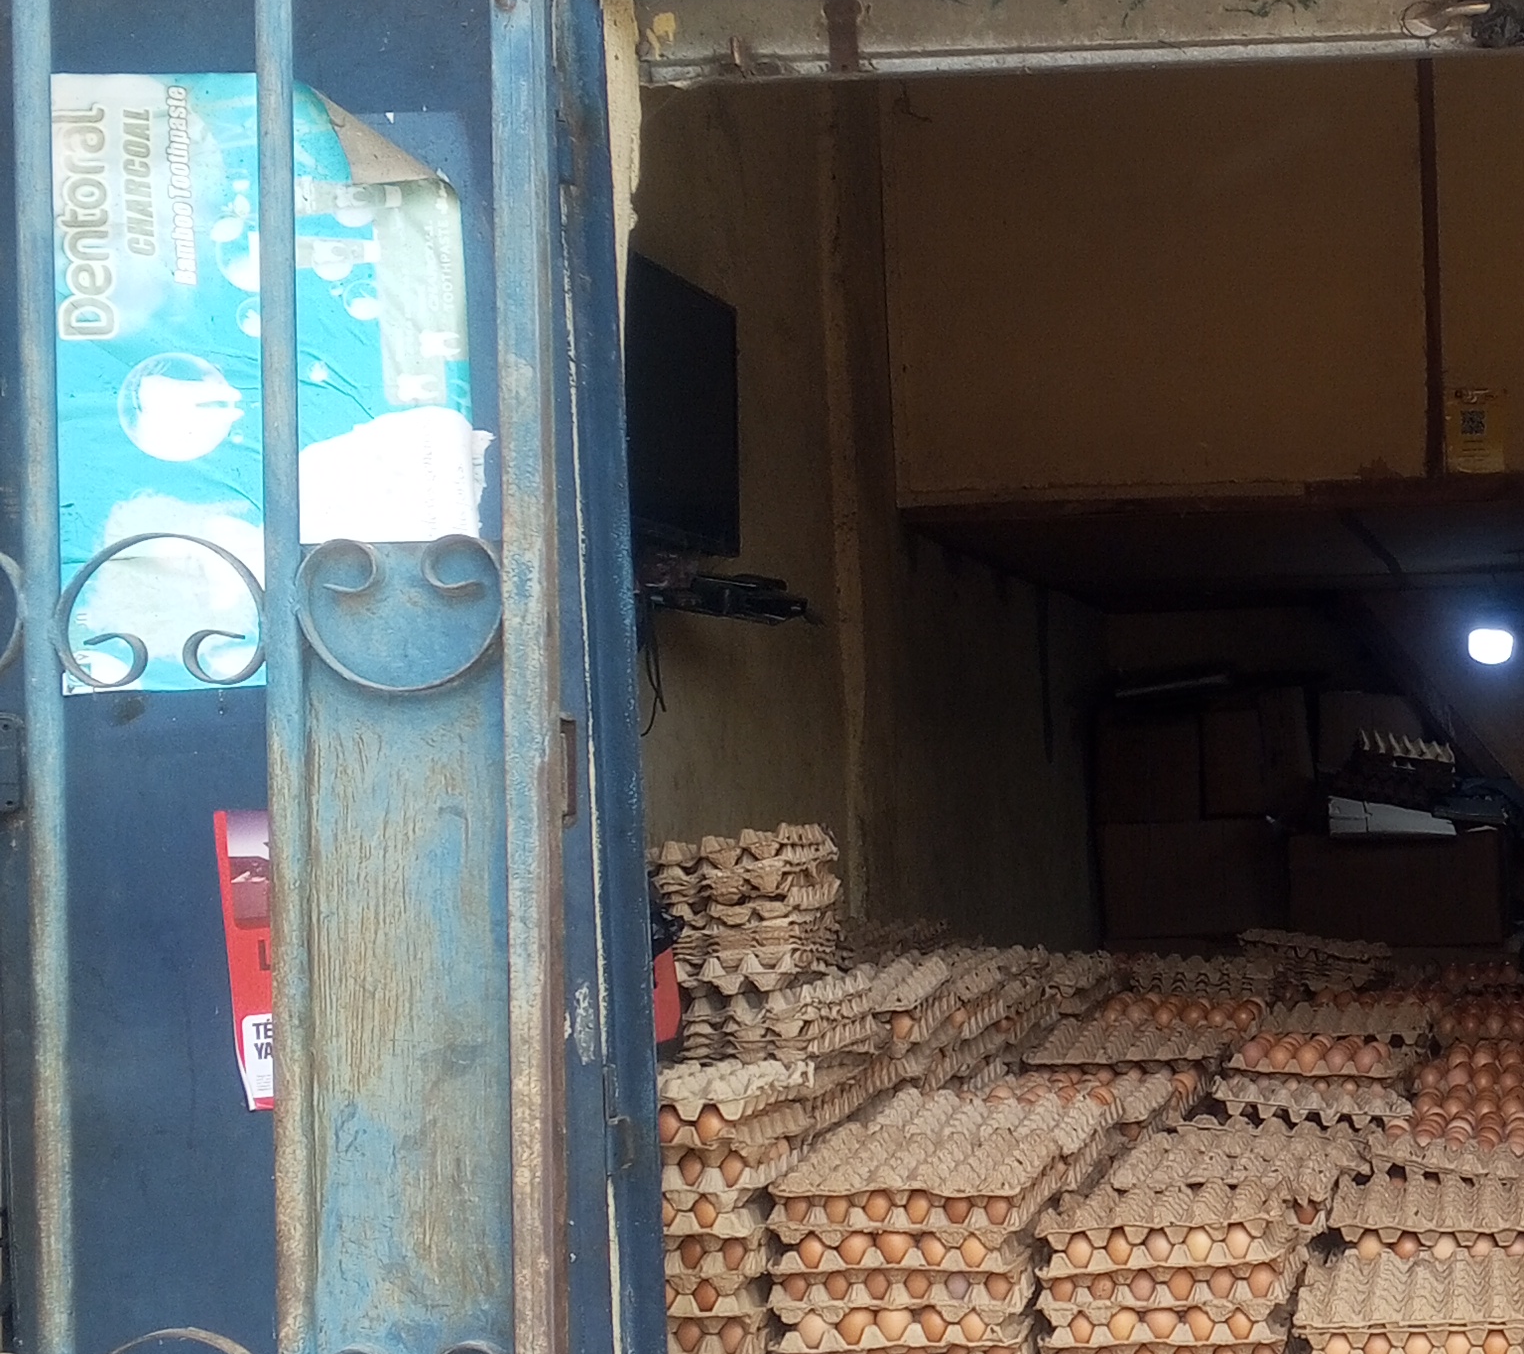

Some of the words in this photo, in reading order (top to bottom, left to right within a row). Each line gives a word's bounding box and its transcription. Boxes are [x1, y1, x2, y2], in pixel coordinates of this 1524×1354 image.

[122, 107, 157, 257] CHARCOAL
[165, 85, 192, 199] Toothpaste
[53, 105, 117, 339] Dentoral
[169, 202, 198, 286] Bamboo
